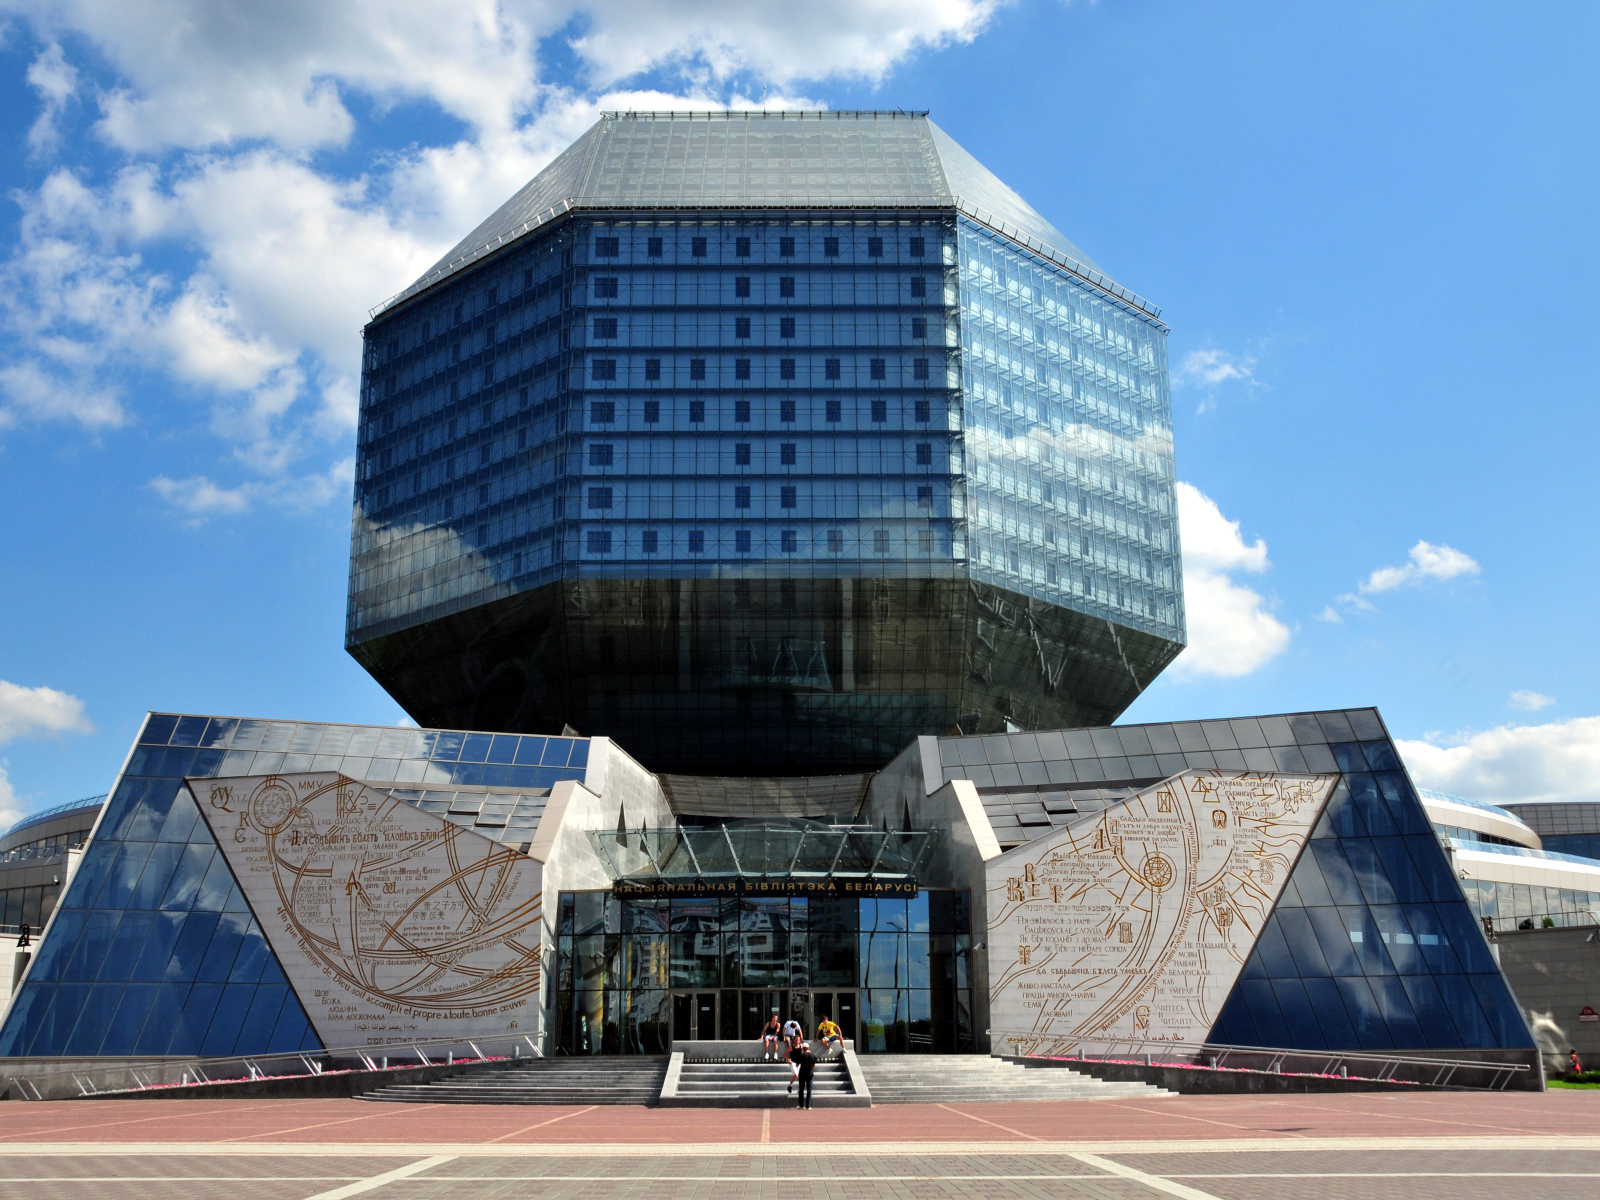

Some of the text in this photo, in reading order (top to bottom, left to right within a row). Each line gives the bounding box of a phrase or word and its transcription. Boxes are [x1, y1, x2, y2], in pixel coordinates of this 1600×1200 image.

[614, 882, 736, 894] НАЦЫЯНАЛЬНАЯ
[846, 883, 917, 892] БЕЛАРУСІ
[412, 1009, 442, 1021] propre
[472, 1006, 498, 1018] bonne
